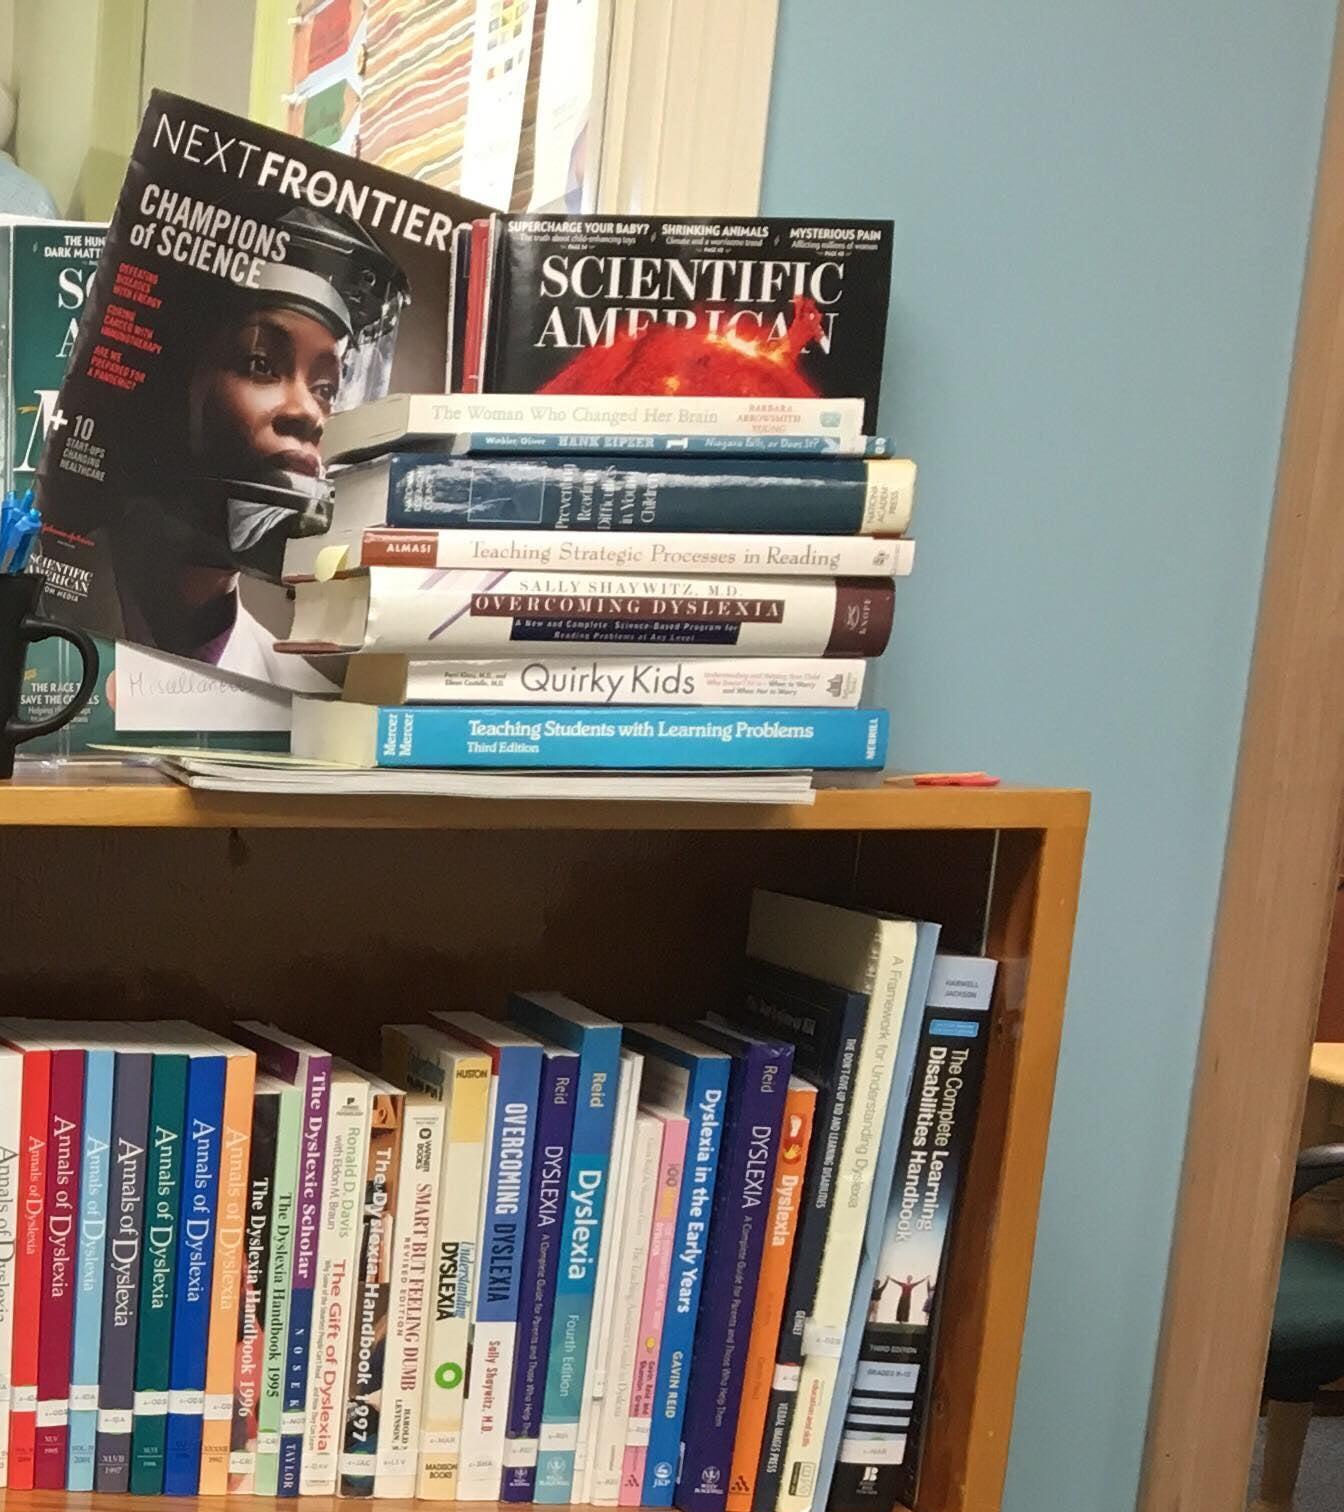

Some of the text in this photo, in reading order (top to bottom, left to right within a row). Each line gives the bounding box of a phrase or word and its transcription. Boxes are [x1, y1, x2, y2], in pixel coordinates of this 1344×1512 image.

[151, 113, 261, 180] NEXT
[141, 184, 290, 263] CHAMPIONS
[130, 222, 267, 289] of SCIENCE
[537, 254, 844, 309] SCIENTIFIC
[386, 542, 432, 554] ALMASI
[470, 541, 840, 569] Teaching Strategic Processes in Reading
[474, 596, 782, 619] OVERCOMING DYSLEXIA
[520, 662, 623, 702] Quirky
[630, 665, 696, 695] Kids
[467, 741, 540, 753] Third Edition
[468, 720, 813, 741] Teaching Students with Learning Problems
[296, 1072, 327, 1278] The Dyslexic Scholar
[49, 1115, 77, 1298] Annals of Dyslexia
[568, 1170, 602, 1280] Dyslexia
